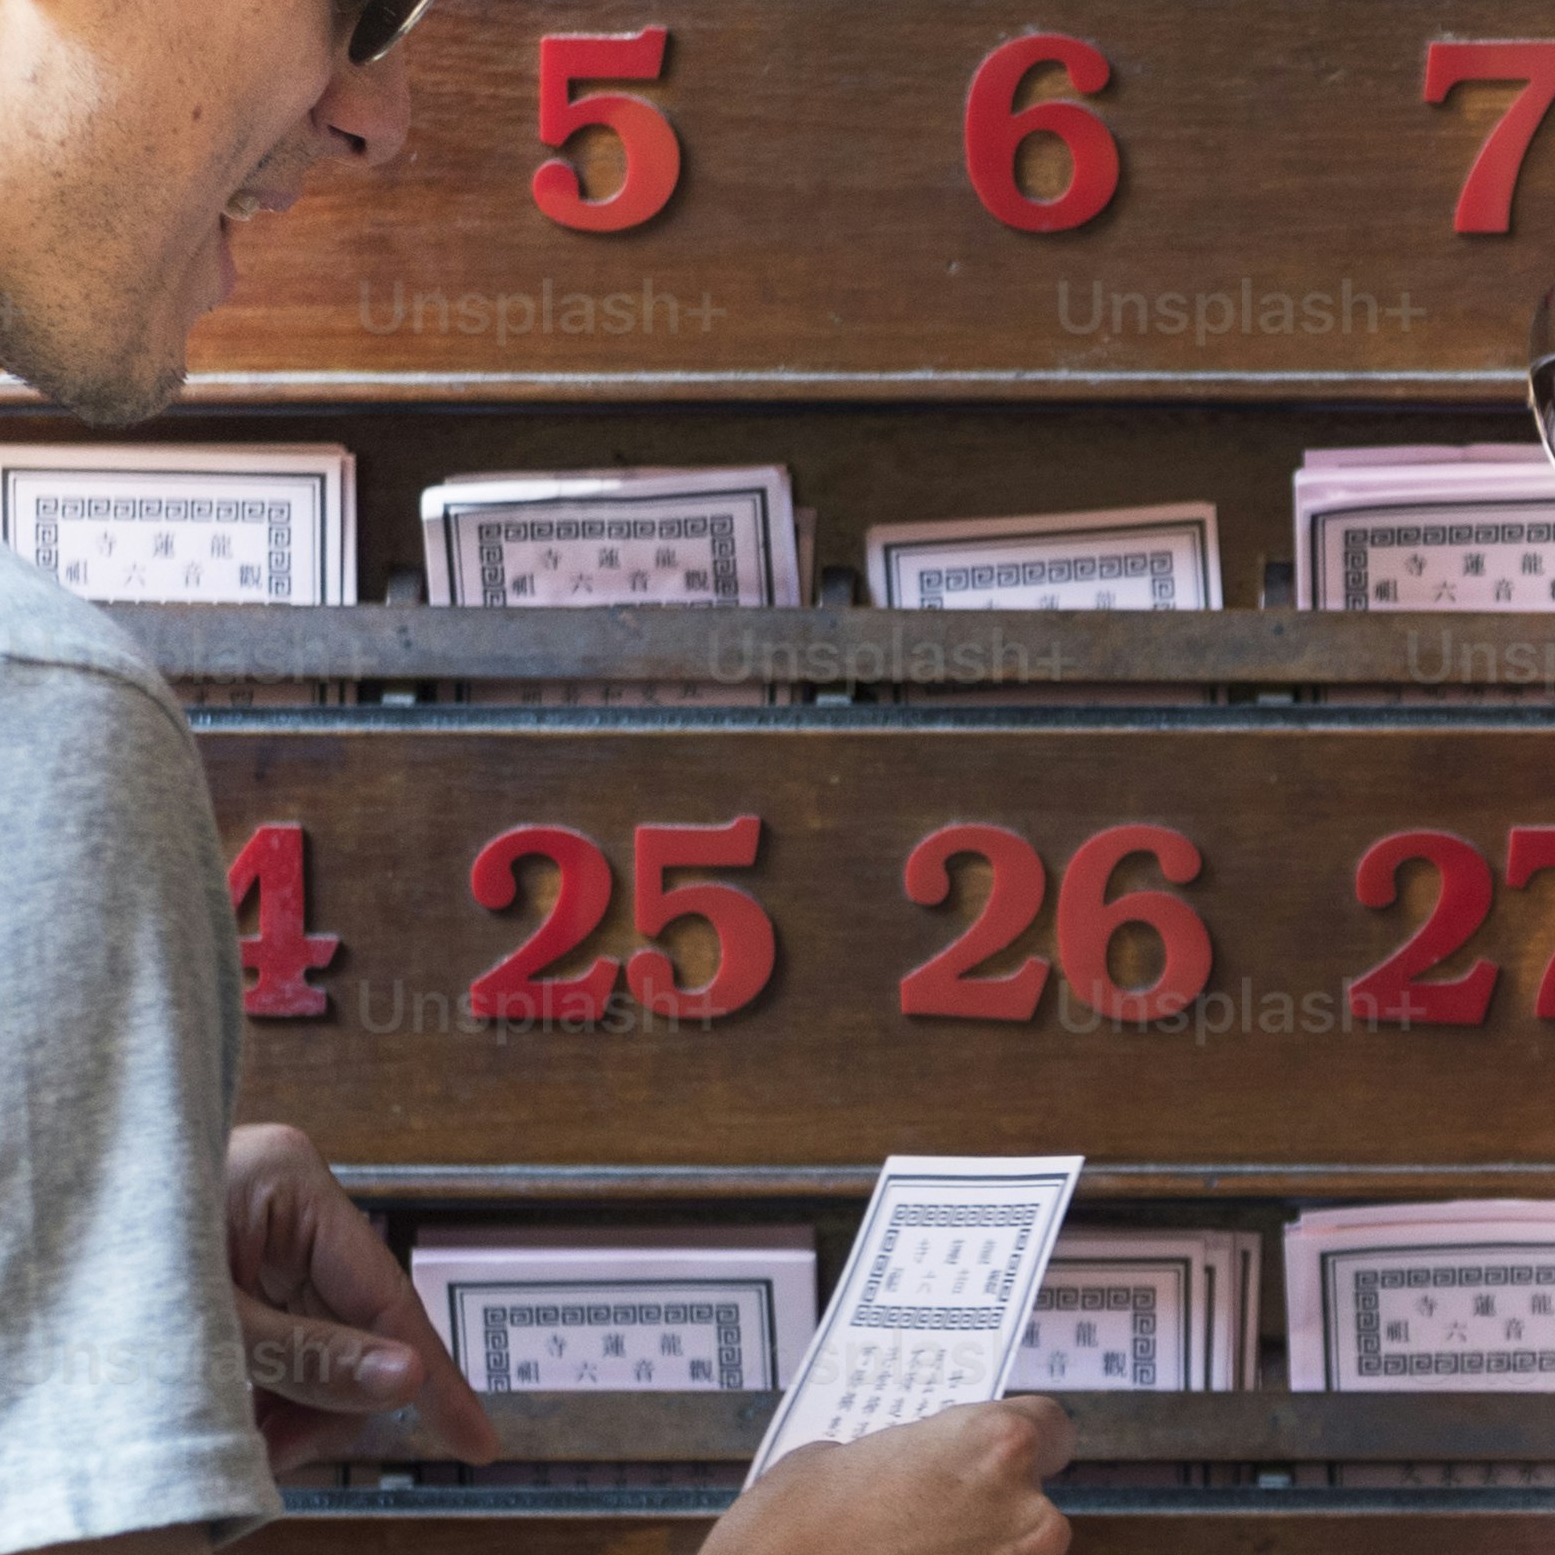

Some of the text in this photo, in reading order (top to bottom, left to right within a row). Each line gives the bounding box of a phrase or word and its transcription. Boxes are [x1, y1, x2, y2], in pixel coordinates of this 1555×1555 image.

[532, 26, 680, 232] 5
[965, 33, 1120, 232] 6
[229, 822, 341, 1017] 4
[470, 816, 775, 1020] 25
[900, 823, 1213, 1021] 26
